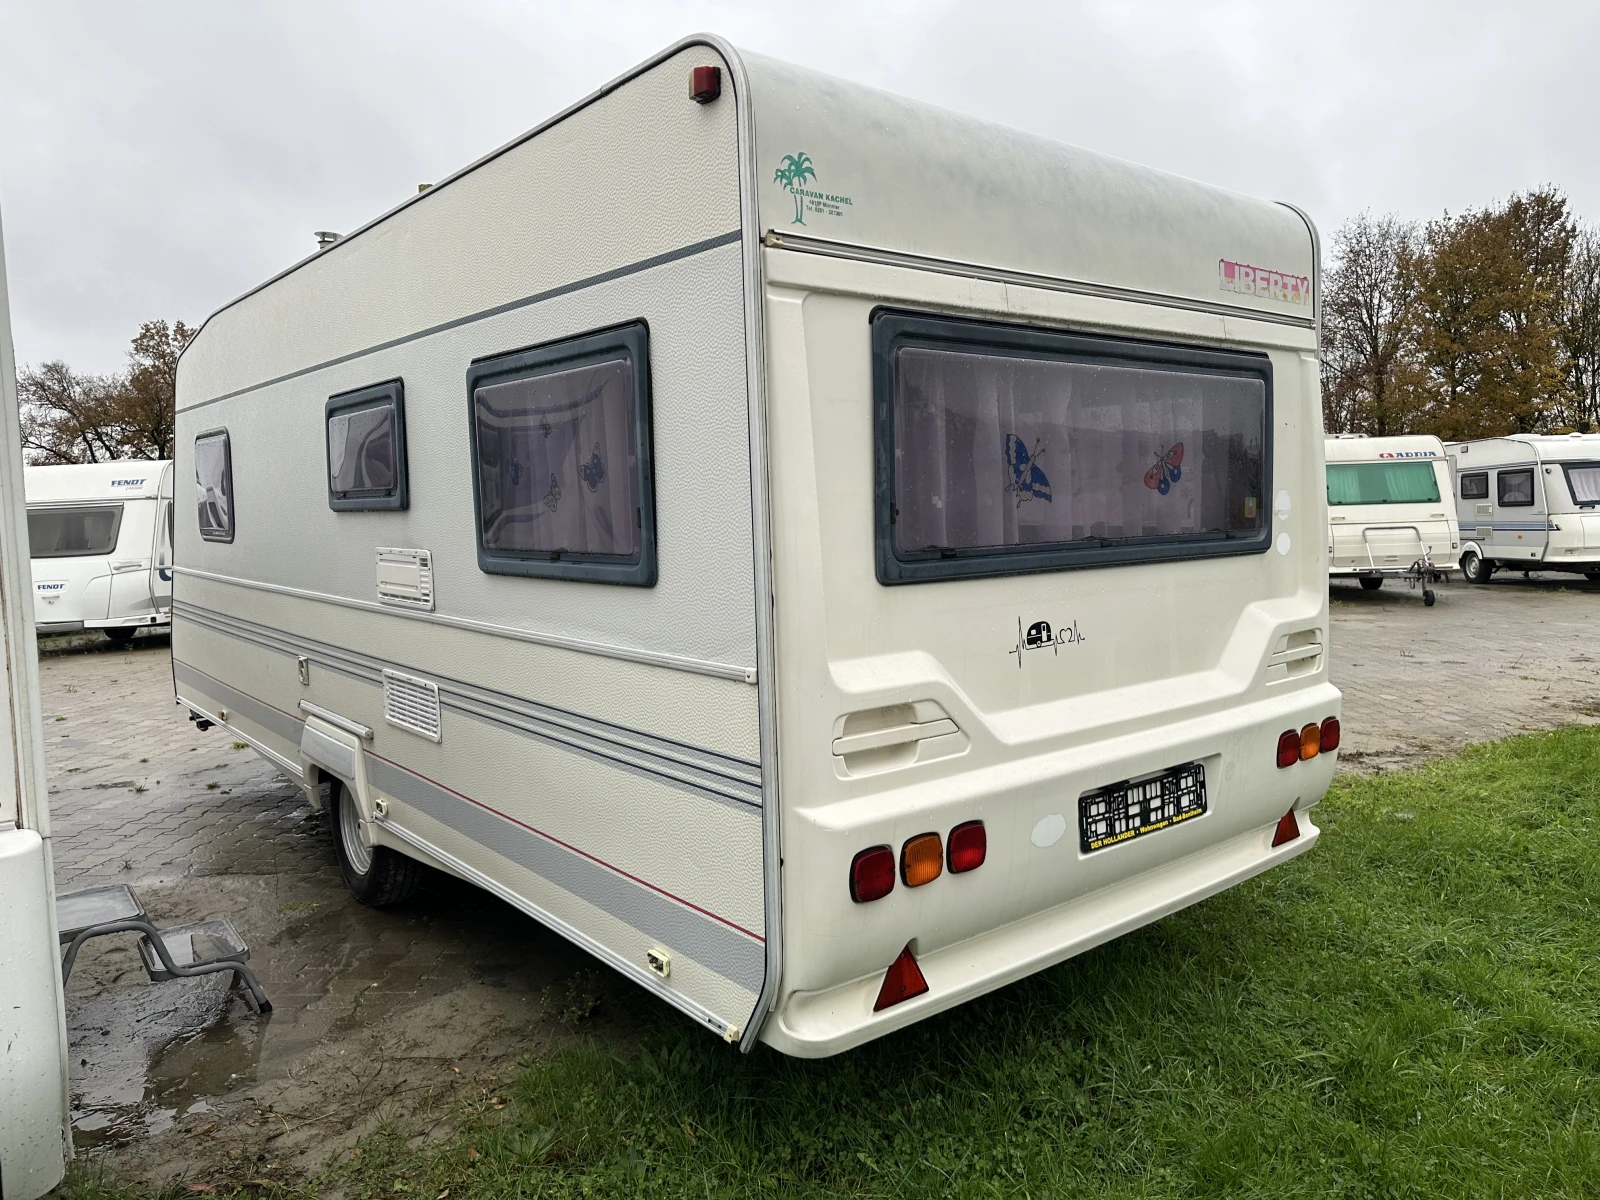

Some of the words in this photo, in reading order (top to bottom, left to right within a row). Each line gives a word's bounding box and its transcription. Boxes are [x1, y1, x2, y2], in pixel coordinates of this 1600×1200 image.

[790, 187, 824, 200] CARAVAN
[826, 194, 853, 205] KACHEL
[1219, 259, 1309, 306] LIBERTY
[1091, 840, 1103, 849] DER
[1103, 830, 1136, 845] HOLLANDER
[1140, 820, 1169, 834] Wohnwagen
